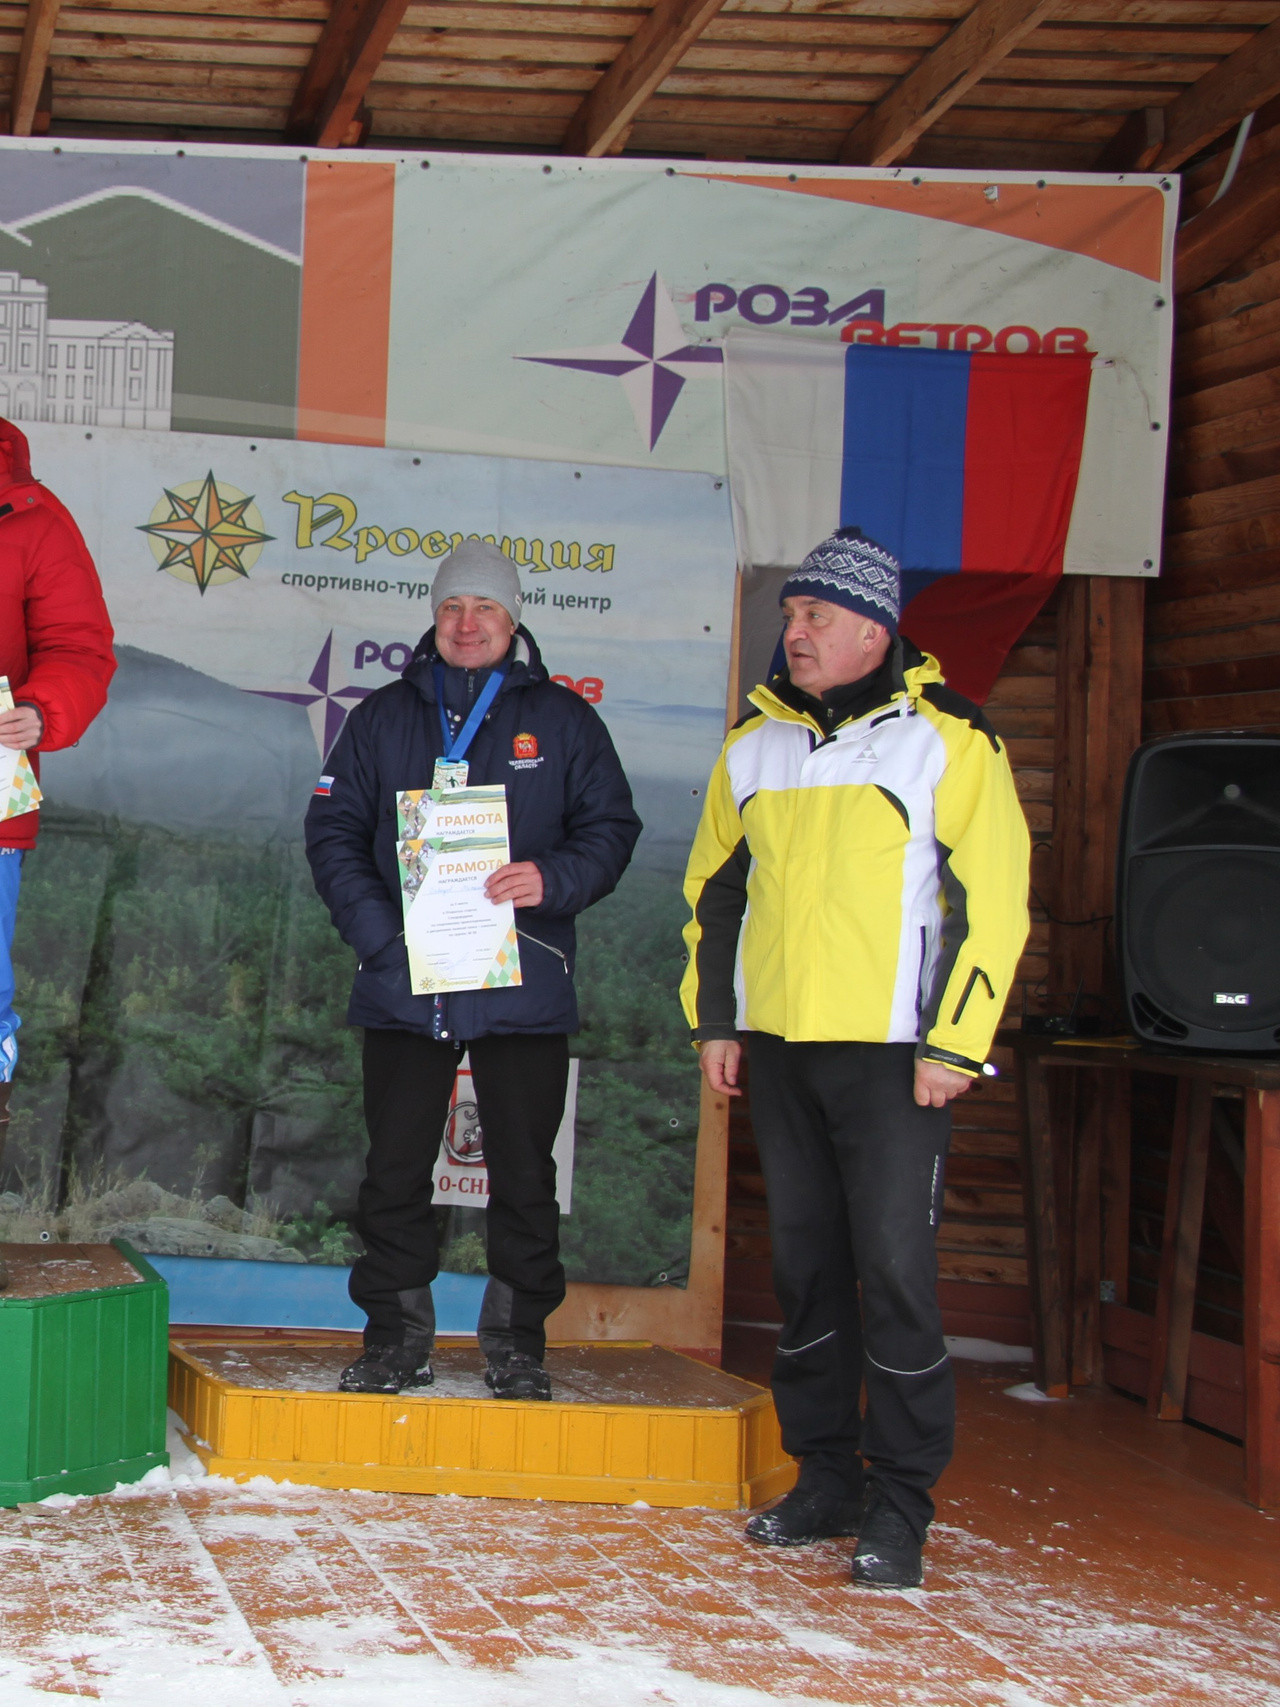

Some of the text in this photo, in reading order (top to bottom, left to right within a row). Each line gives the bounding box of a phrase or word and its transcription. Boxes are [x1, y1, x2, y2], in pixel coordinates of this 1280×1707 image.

[695, 283, 885, 326] РОЗА
[552, 592, 612, 613] центр
[354, 640, 414, 672] РО
[436, 812, 503, 827] ГРАМОТА
[1216, 994, 1247, 1004] B&G
